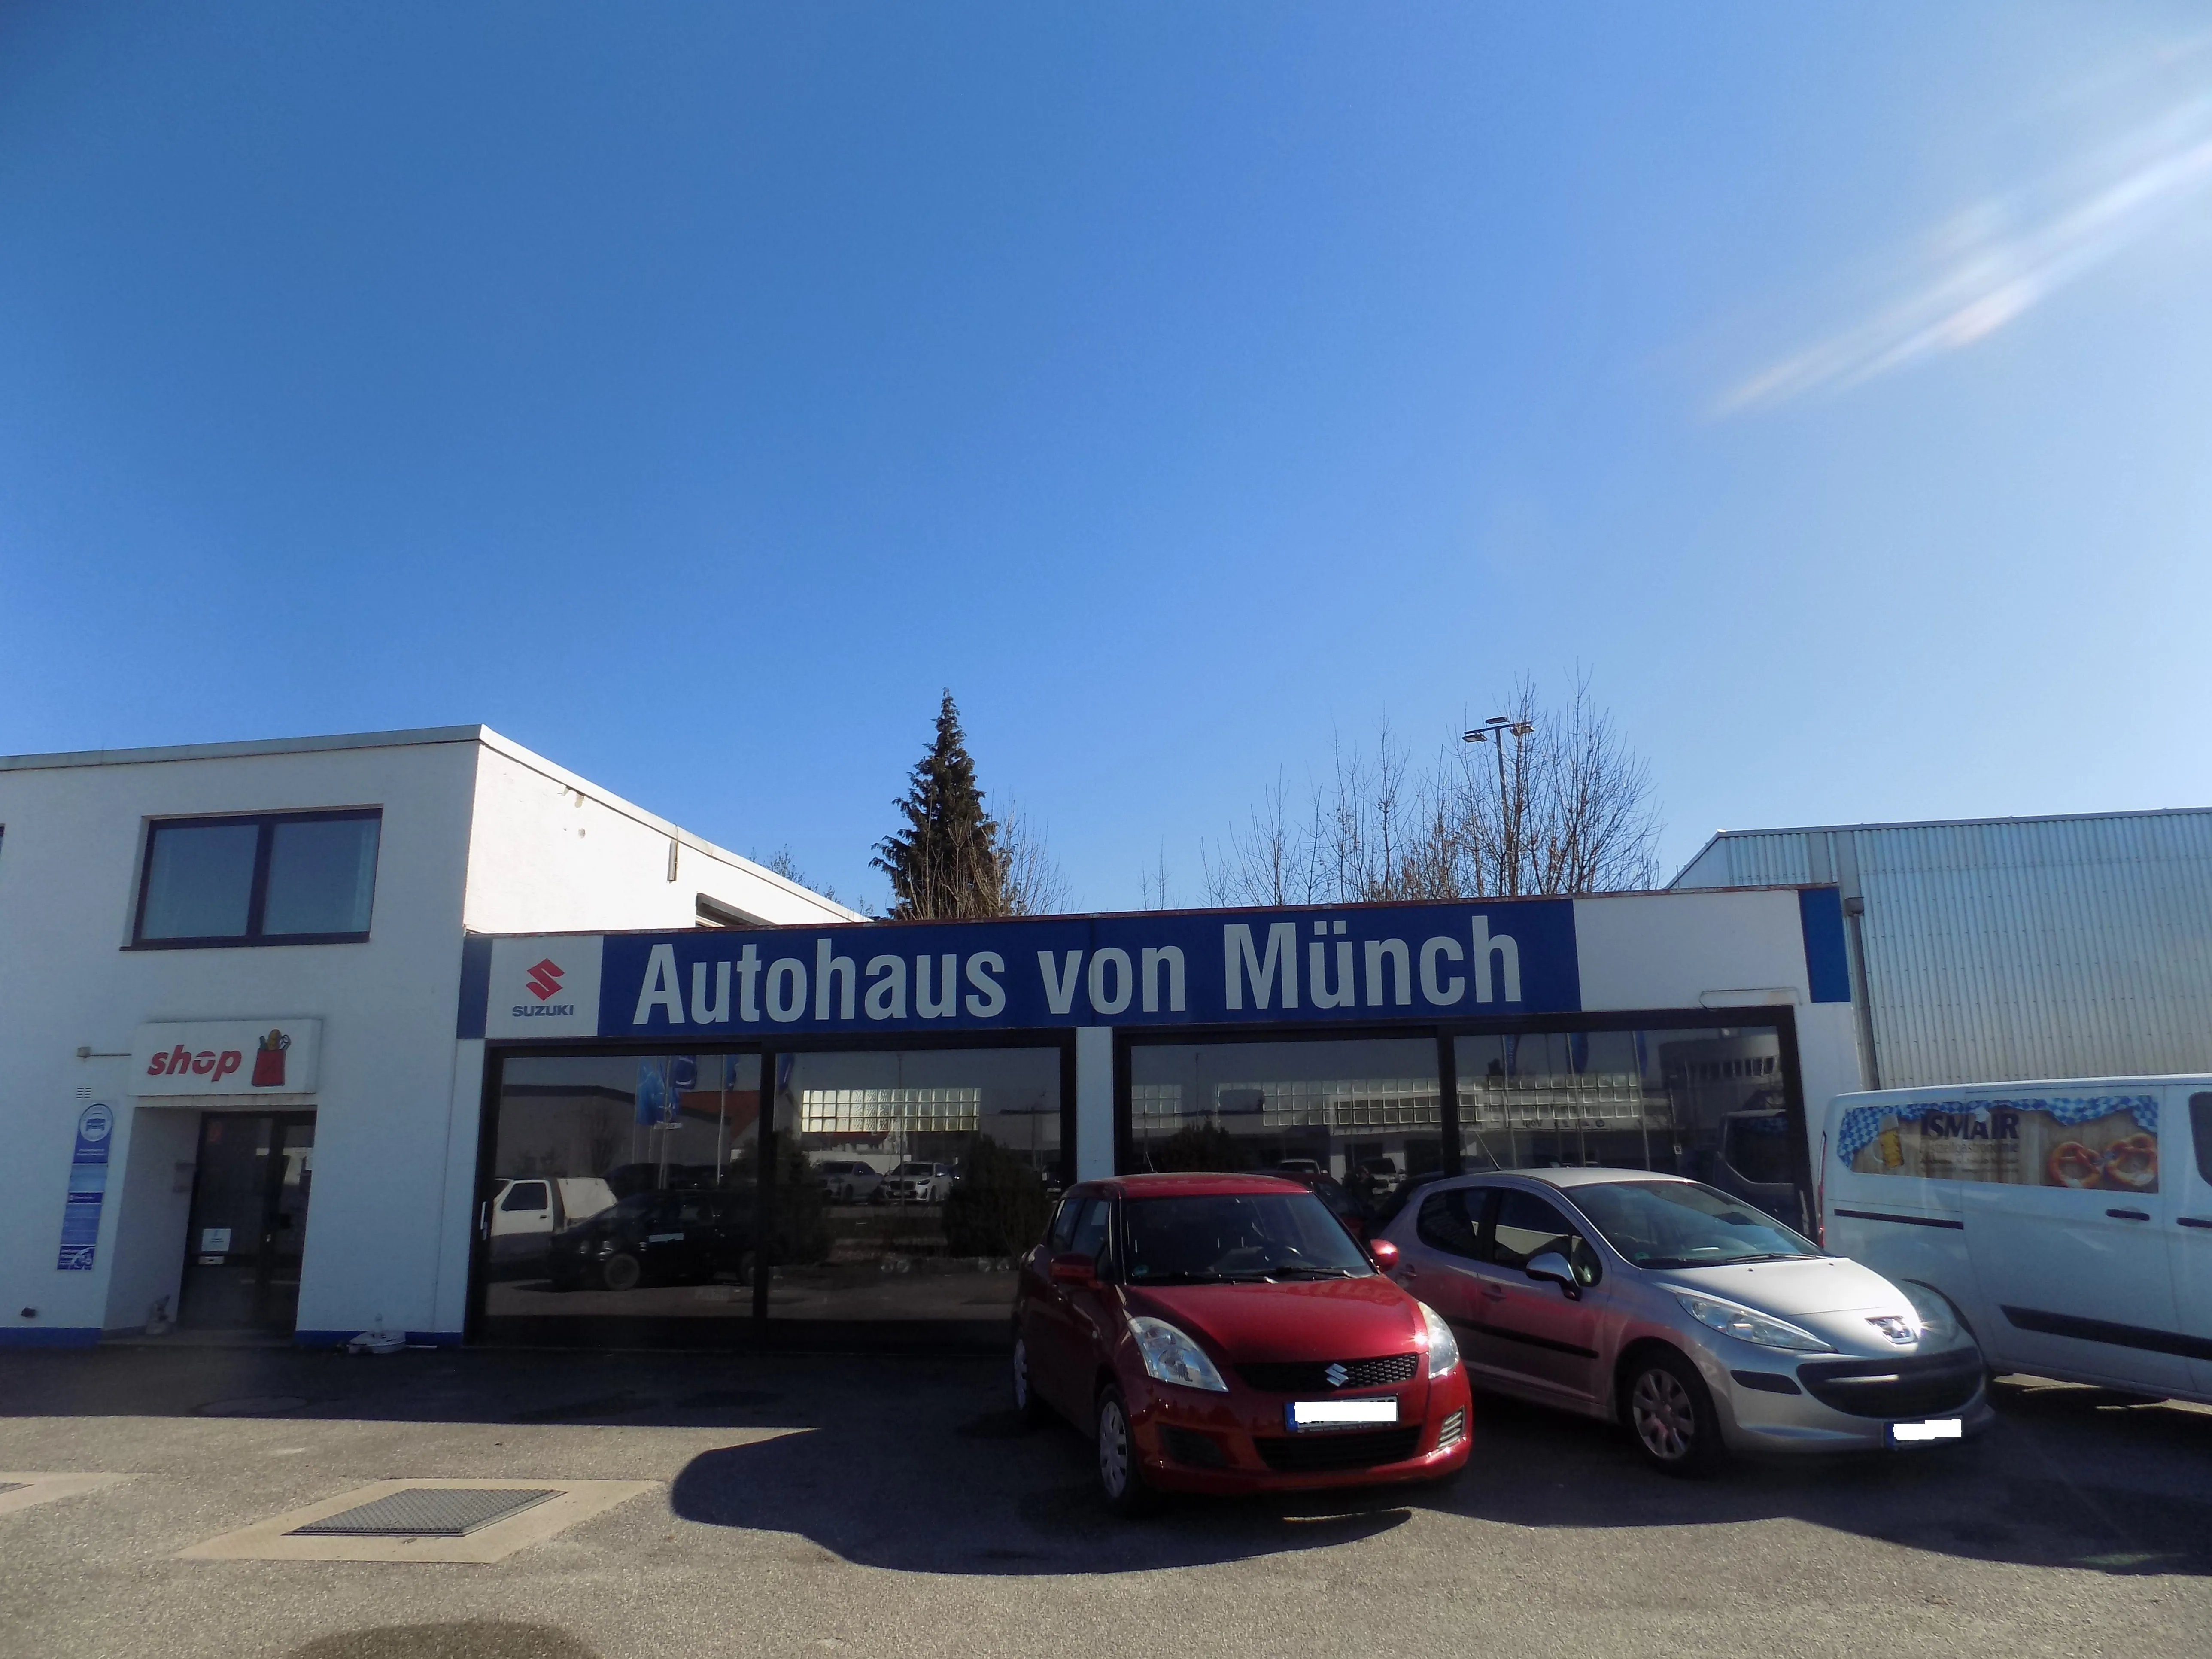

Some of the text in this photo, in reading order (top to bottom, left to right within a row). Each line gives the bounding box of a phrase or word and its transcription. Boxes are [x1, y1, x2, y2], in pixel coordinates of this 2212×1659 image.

[633, 915, 1522, 1025] Autohaus von Münch
[512, 1004, 574, 1017] SUZUKI
[147, 1044, 242, 1082] shop
[1920, 1113, 2020, 1139] ISMAIR
